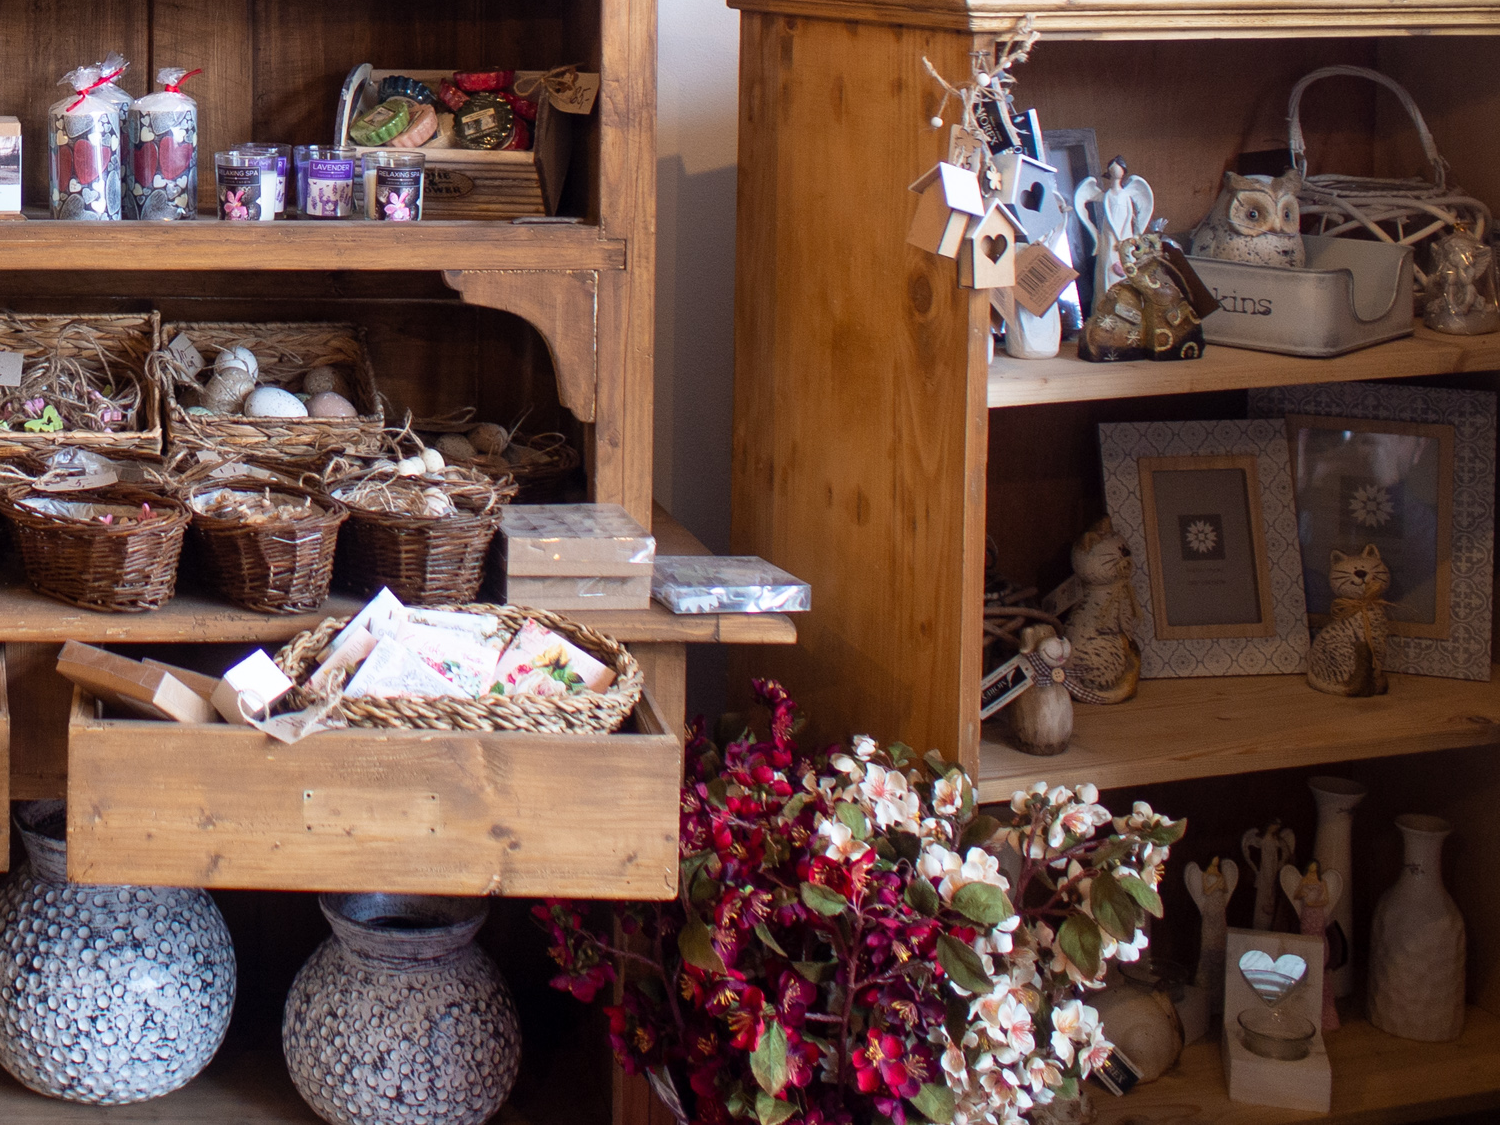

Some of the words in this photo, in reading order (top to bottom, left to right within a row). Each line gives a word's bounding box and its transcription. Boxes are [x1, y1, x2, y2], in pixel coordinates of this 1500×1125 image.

[313, 163, 350, 171] LAVENDER
[378, 170, 409, 178] RELAXING
[424, 171, 451, 180] OME
[424, 186, 461, 194] OWER
[1213, 287, 1272, 316] kins
